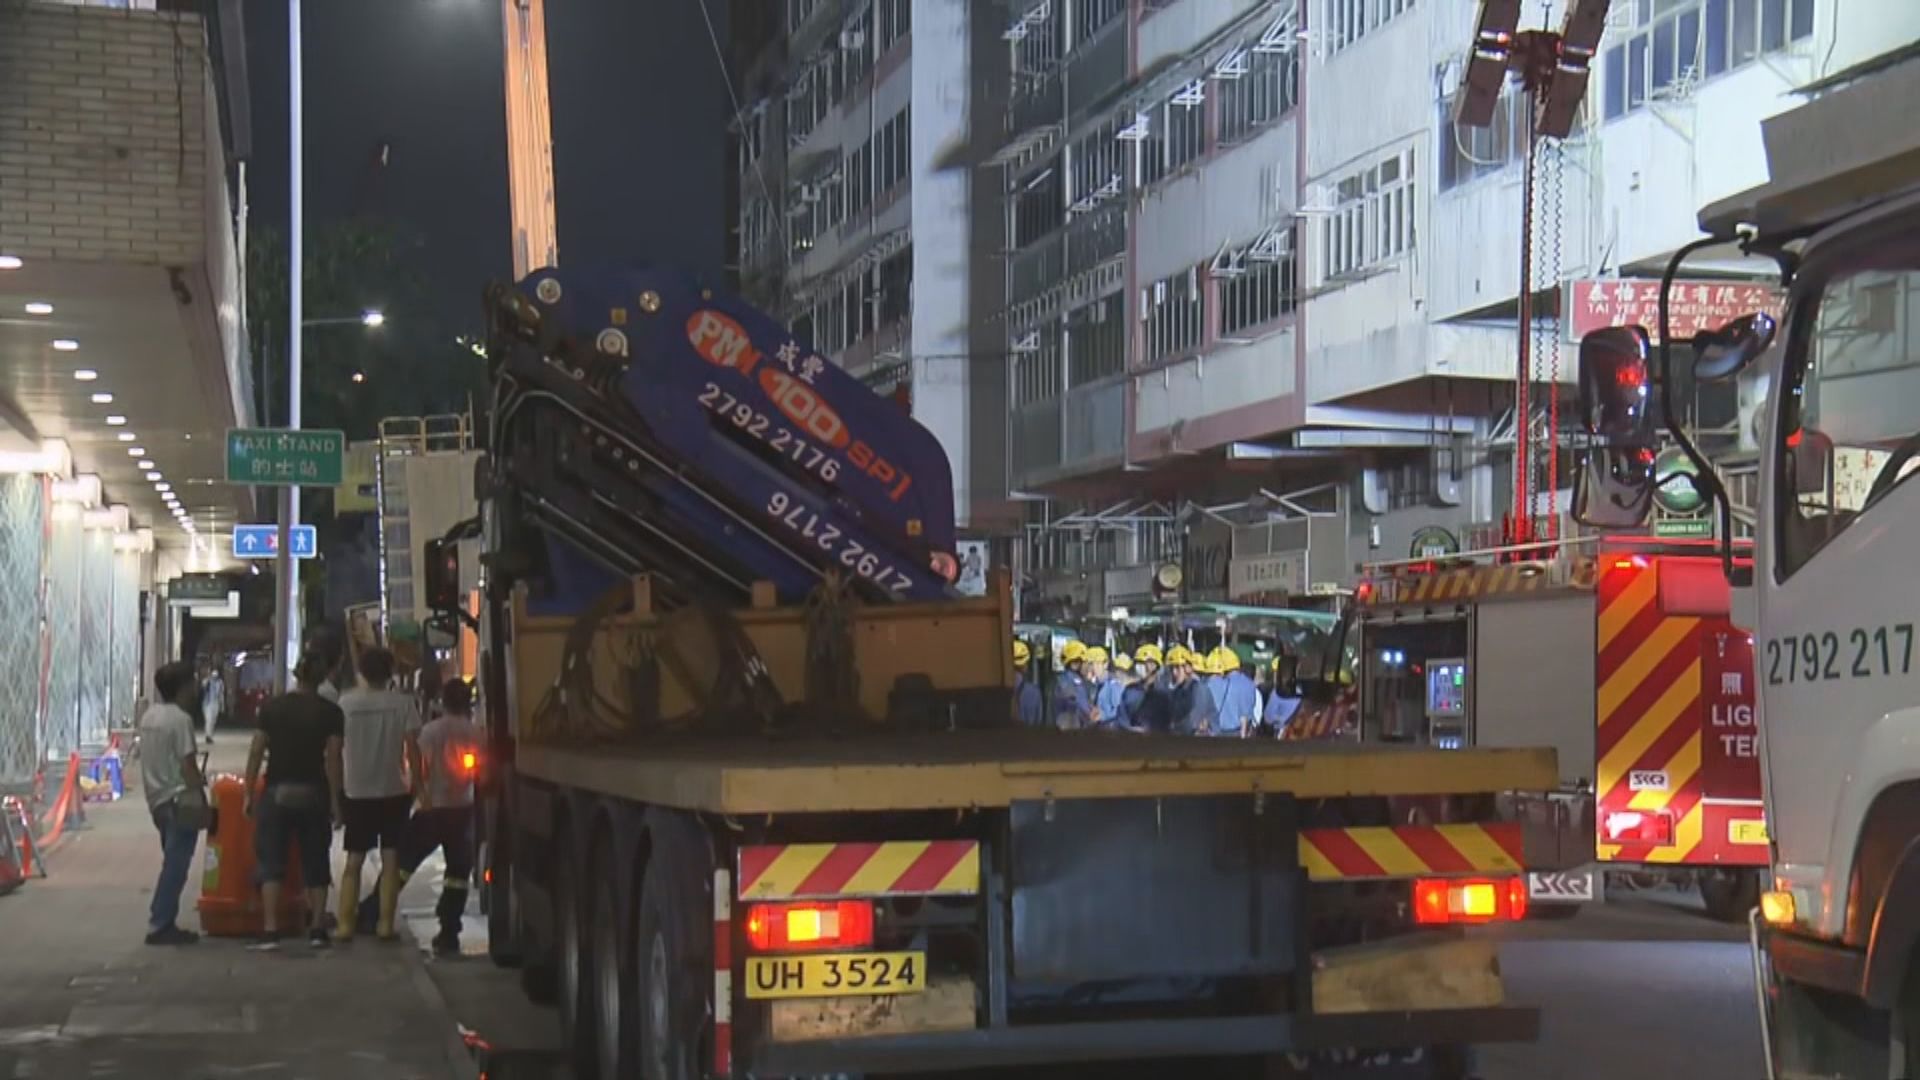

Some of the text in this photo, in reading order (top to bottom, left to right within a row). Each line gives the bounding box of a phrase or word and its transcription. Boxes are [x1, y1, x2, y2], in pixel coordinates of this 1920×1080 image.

[1588, 303, 1609, 314] TAI
[1645, 304, 1731, 316] ENINEERING
[771, 374, 841, 440] 100
[235, 436, 335, 453] TAXI STAND
[698, 382, 841, 482] 2792 2176
[252, 459, 317, 477] 的士站
[768, 491, 841, 549] 2176
[1767, 623, 1914, 686] 2792 217
[1739, 824, 1751, 840] F
[756, 957, 915, 990] UH 3524
